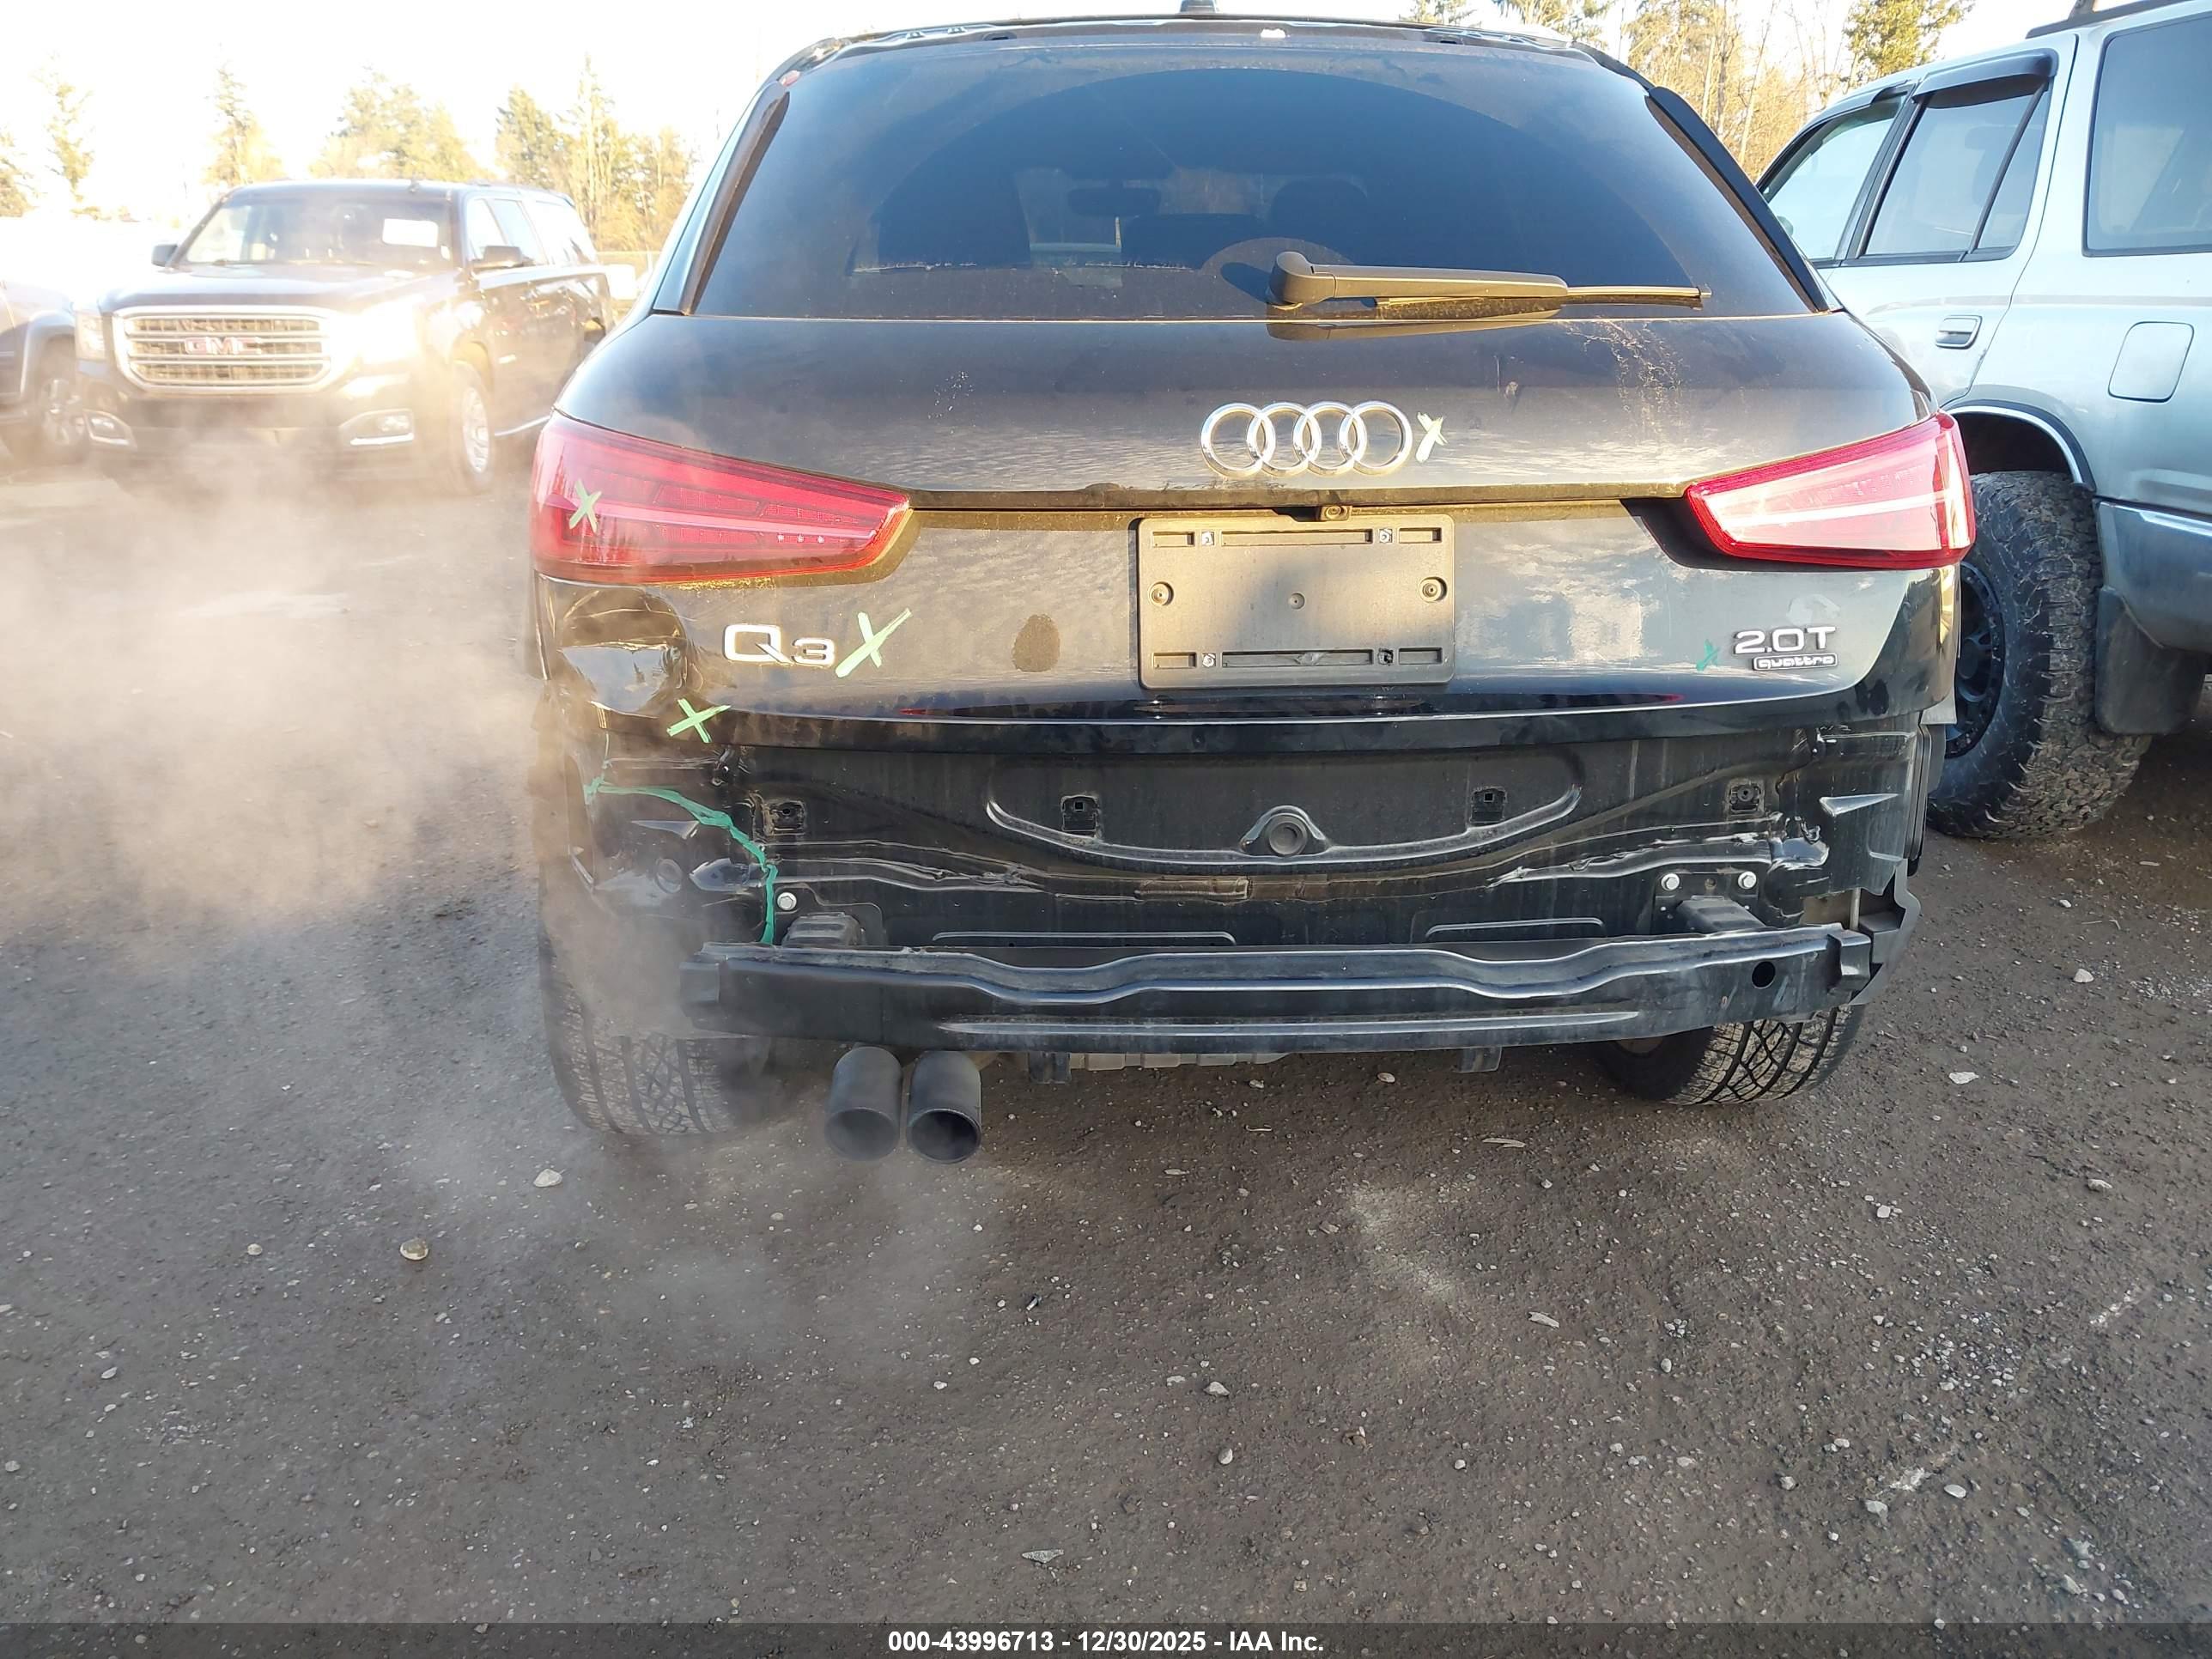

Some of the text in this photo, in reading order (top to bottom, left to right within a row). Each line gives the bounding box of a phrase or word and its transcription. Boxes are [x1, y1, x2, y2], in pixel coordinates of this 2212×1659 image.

[184, 337, 262, 355] GMC
[724, 624, 835, 667] Q3
[1734, 626, 1836, 654] 2.0T
[1757, 655, 1835, 670] quattro
